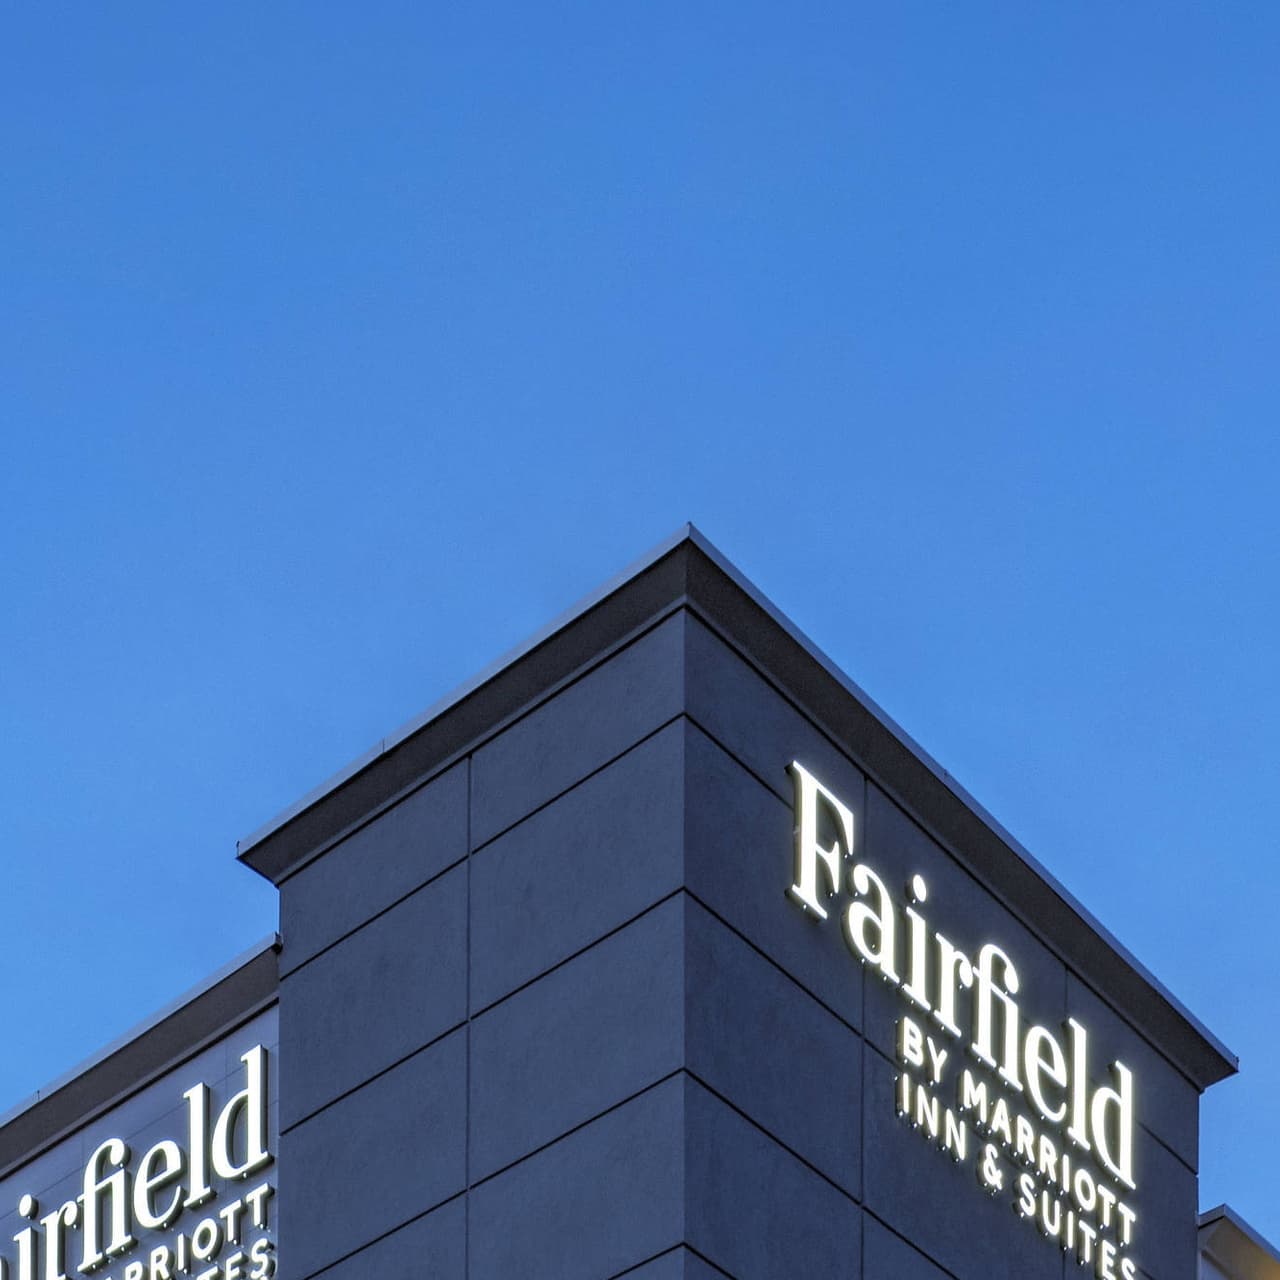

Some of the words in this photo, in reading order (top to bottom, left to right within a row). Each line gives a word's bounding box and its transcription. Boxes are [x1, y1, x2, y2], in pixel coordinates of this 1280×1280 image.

[787, 760, 1136, 1190] Fairfield
[899, 1073, 967, 1161] INN
[981, 1144, 1002, 1191] &
[900, 1016, 947, 1083] BY
[962, 1069, 1136, 1246] MARRIOTT
